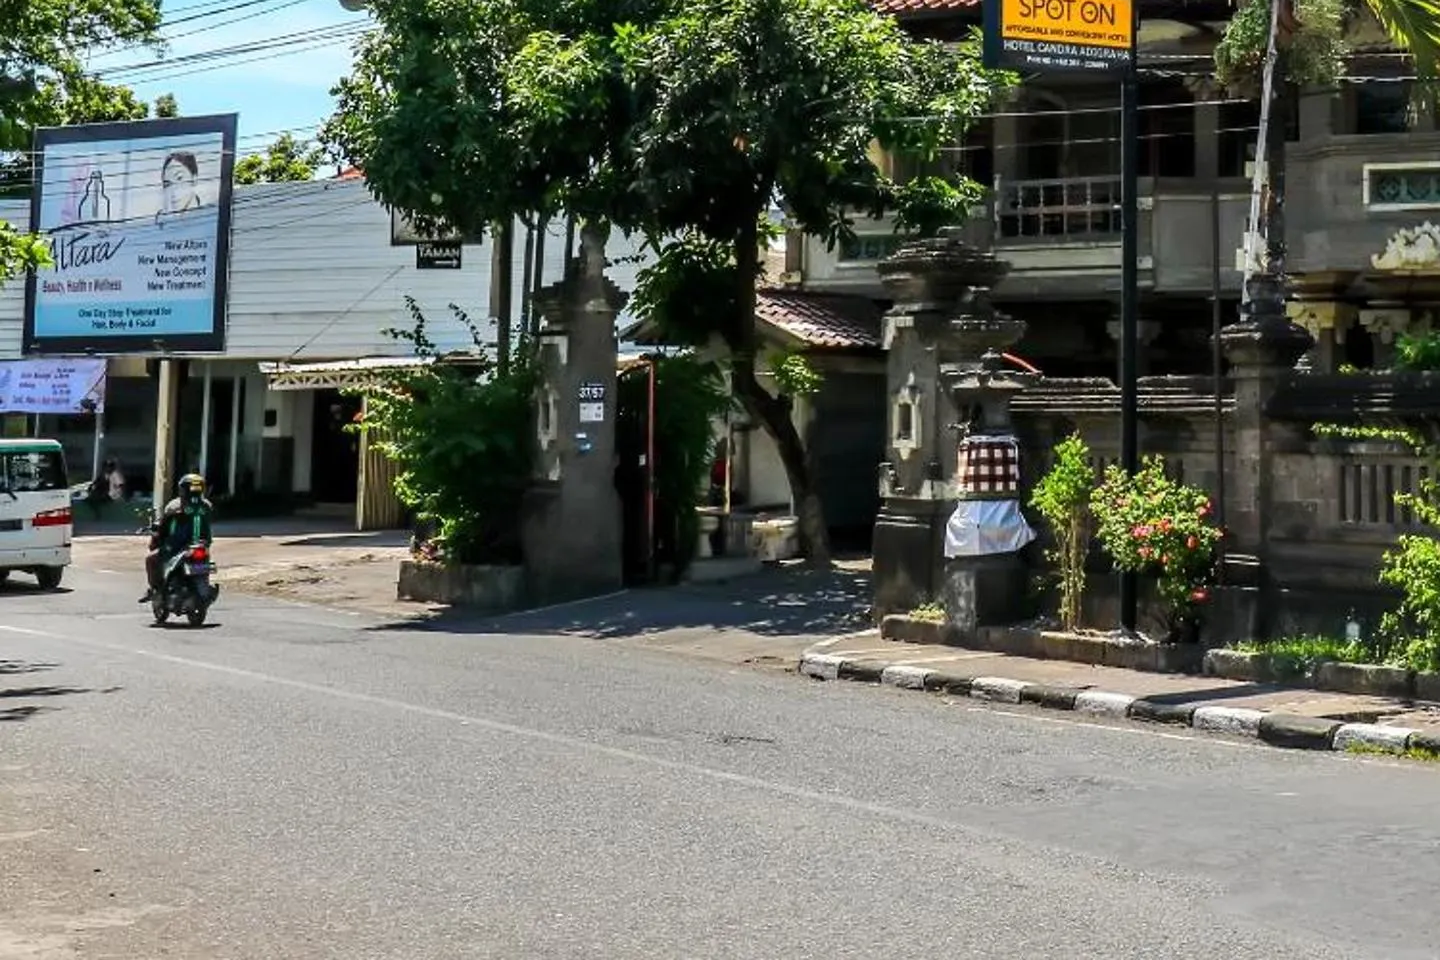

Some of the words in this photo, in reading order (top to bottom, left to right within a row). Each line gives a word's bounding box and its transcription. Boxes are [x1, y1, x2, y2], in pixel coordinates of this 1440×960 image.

[1081, 1, 1115, 25] ON
[1005, 24, 1049, 36] AFFORDABLE
[1003, 40, 1036, 53] HOTEL
[1037, 42, 1077, 56] CANDRA
[420, 246, 460, 258] TAMAN
[137, 254, 155, 265] New
[156, 253, 206, 266] Management
[155, 267, 171, 278] New
[172, 266, 206, 279] Concept
[147, 280, 164, 292] New
[166, 279, 206, 291] Treatment
[78, 308, 92, 318] One
[109, 319, 127, 330] Body
[136, 318, 156, 328] Facial
